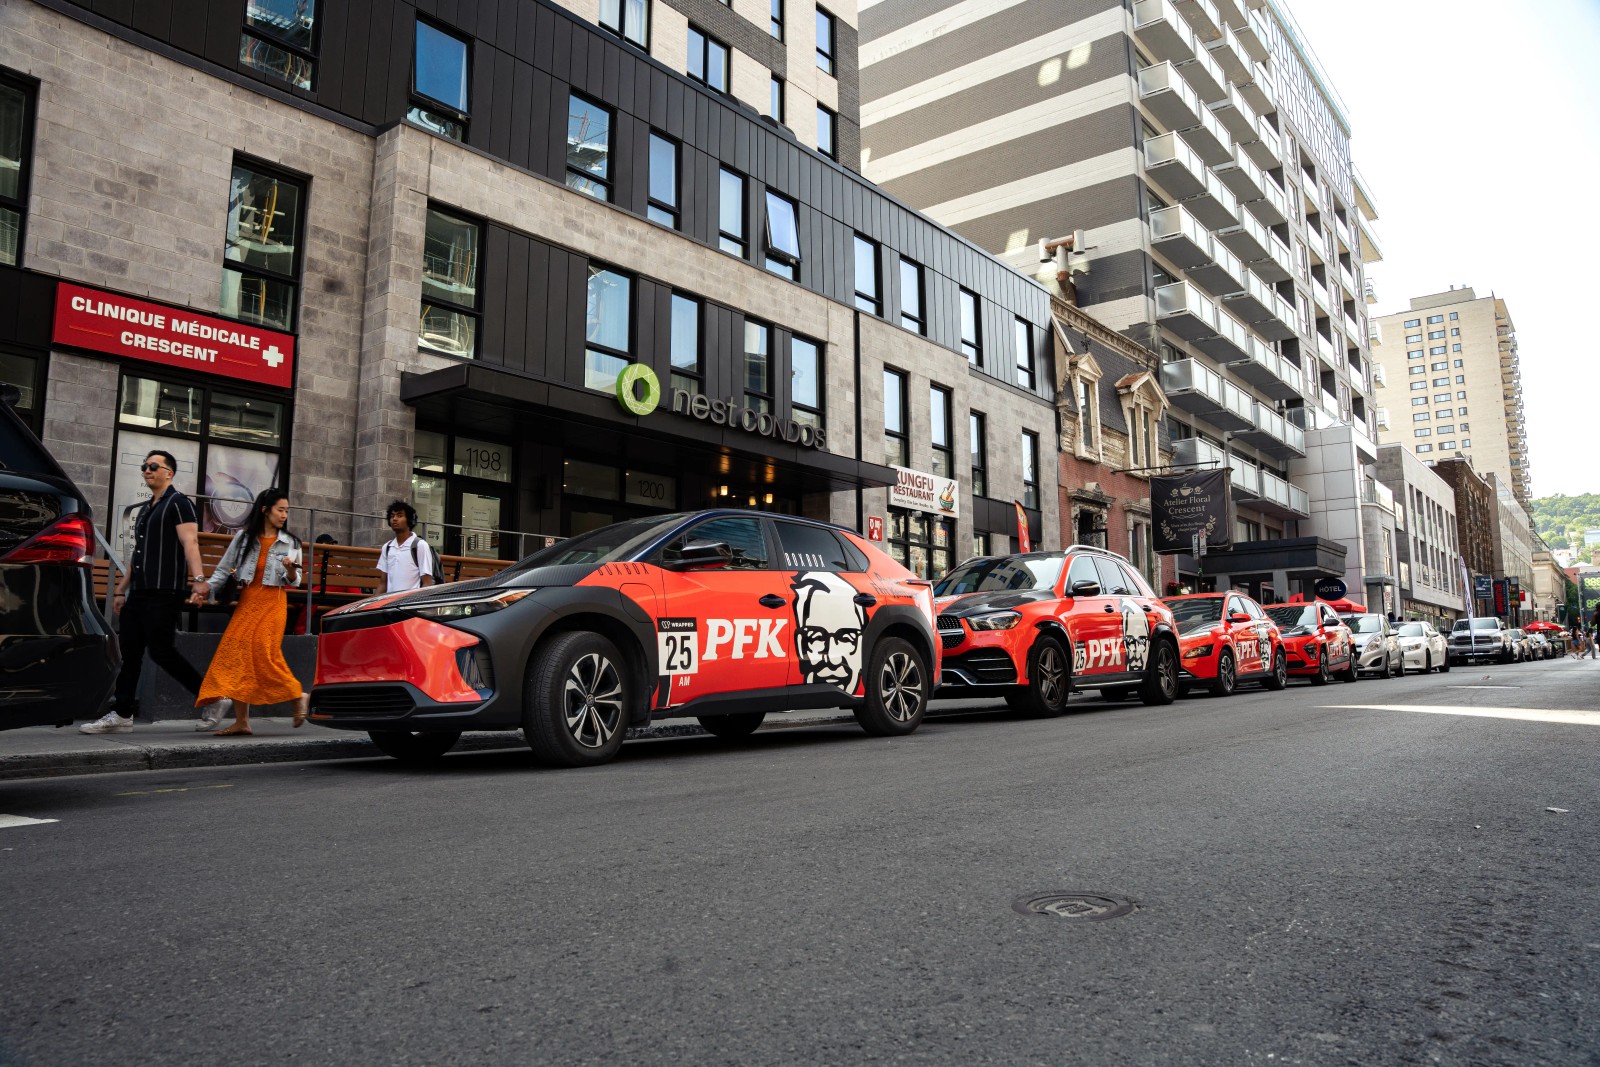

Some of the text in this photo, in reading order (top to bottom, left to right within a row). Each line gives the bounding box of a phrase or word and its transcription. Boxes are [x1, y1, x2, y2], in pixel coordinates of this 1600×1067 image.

[71, 296, 260, 350] CLINIQUE MÉDICALE
[120, 331, 218, 362] CRESCENT
[672, 387, 737, 428] nest
[466, 447, 501, 471] 1198
[638, 480, 665, 500] 1200
[894, 486, 934, 502] RESTAURANT
[1189, 495, 1210, 503] Floral
[1168, 505, 1205, 514] Crescent
[1319, 585, 1342, 593] HÔTEL
[702, 618, 788, 660] PFK
[665, 635, 692, 671] 25
[1075, 650, 1085, 670] 25
[1086, 638, 1123, 668] PFK
[1240, 640, 1258, 660] PFK
[678, 676, 691, 687] AM
